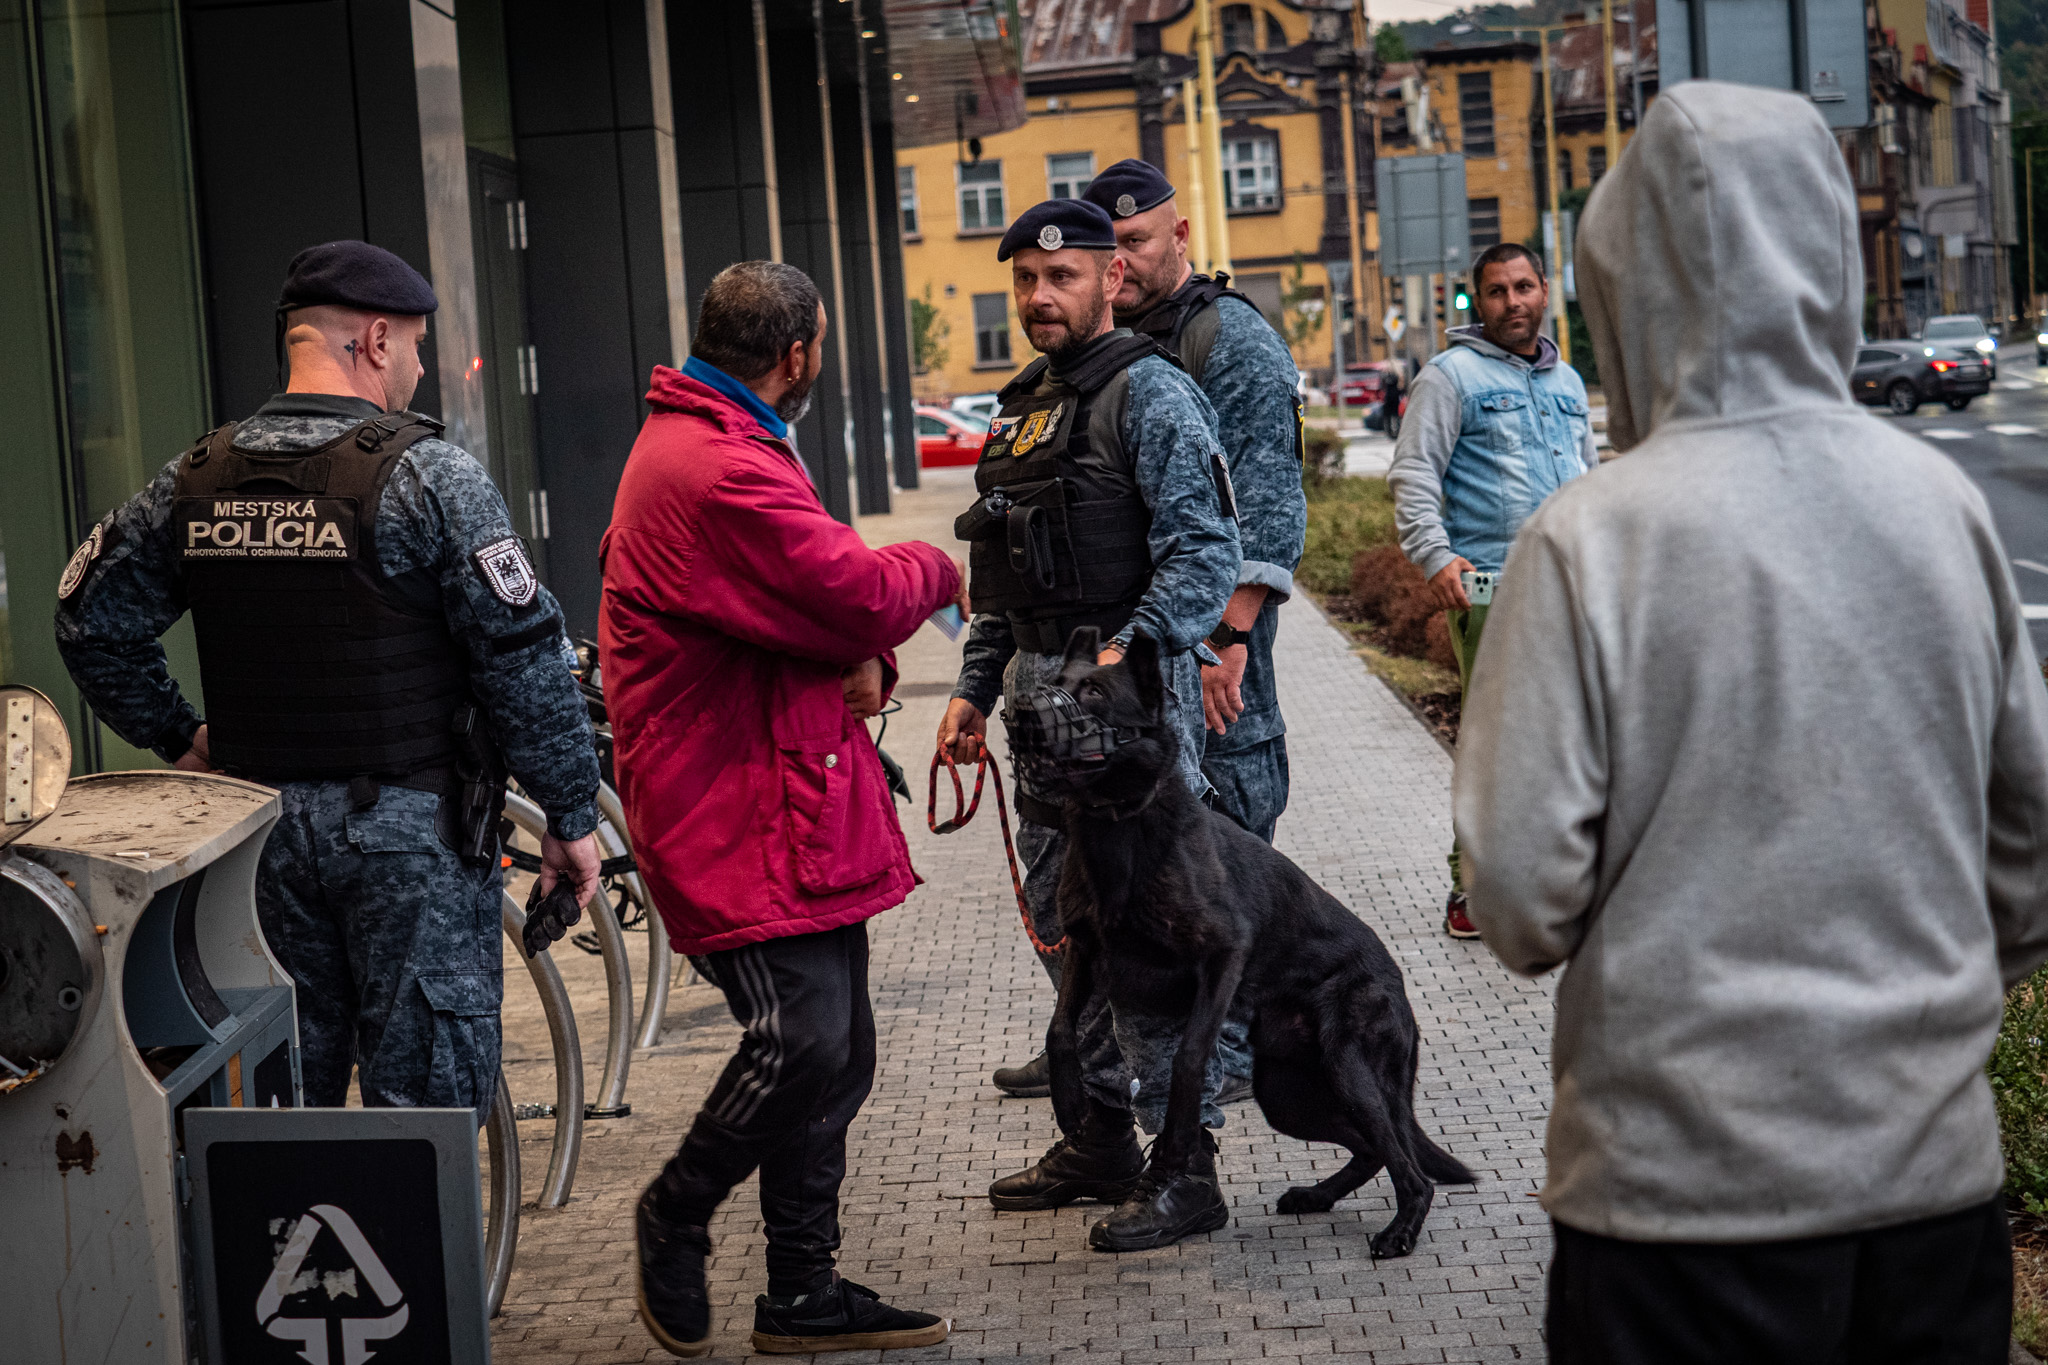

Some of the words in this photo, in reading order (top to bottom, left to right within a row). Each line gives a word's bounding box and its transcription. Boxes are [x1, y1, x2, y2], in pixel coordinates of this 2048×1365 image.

[213, 499, 317, 517] MESTSKÁ
[188, 516, 347, 548] POLÍCIA
[184, 547, 249, 557] POHOTOVOSTNÁ
[251, 548, 300, 557] OCHRANNÁ
[301, 549, 348, 558] JEDNOTKA
